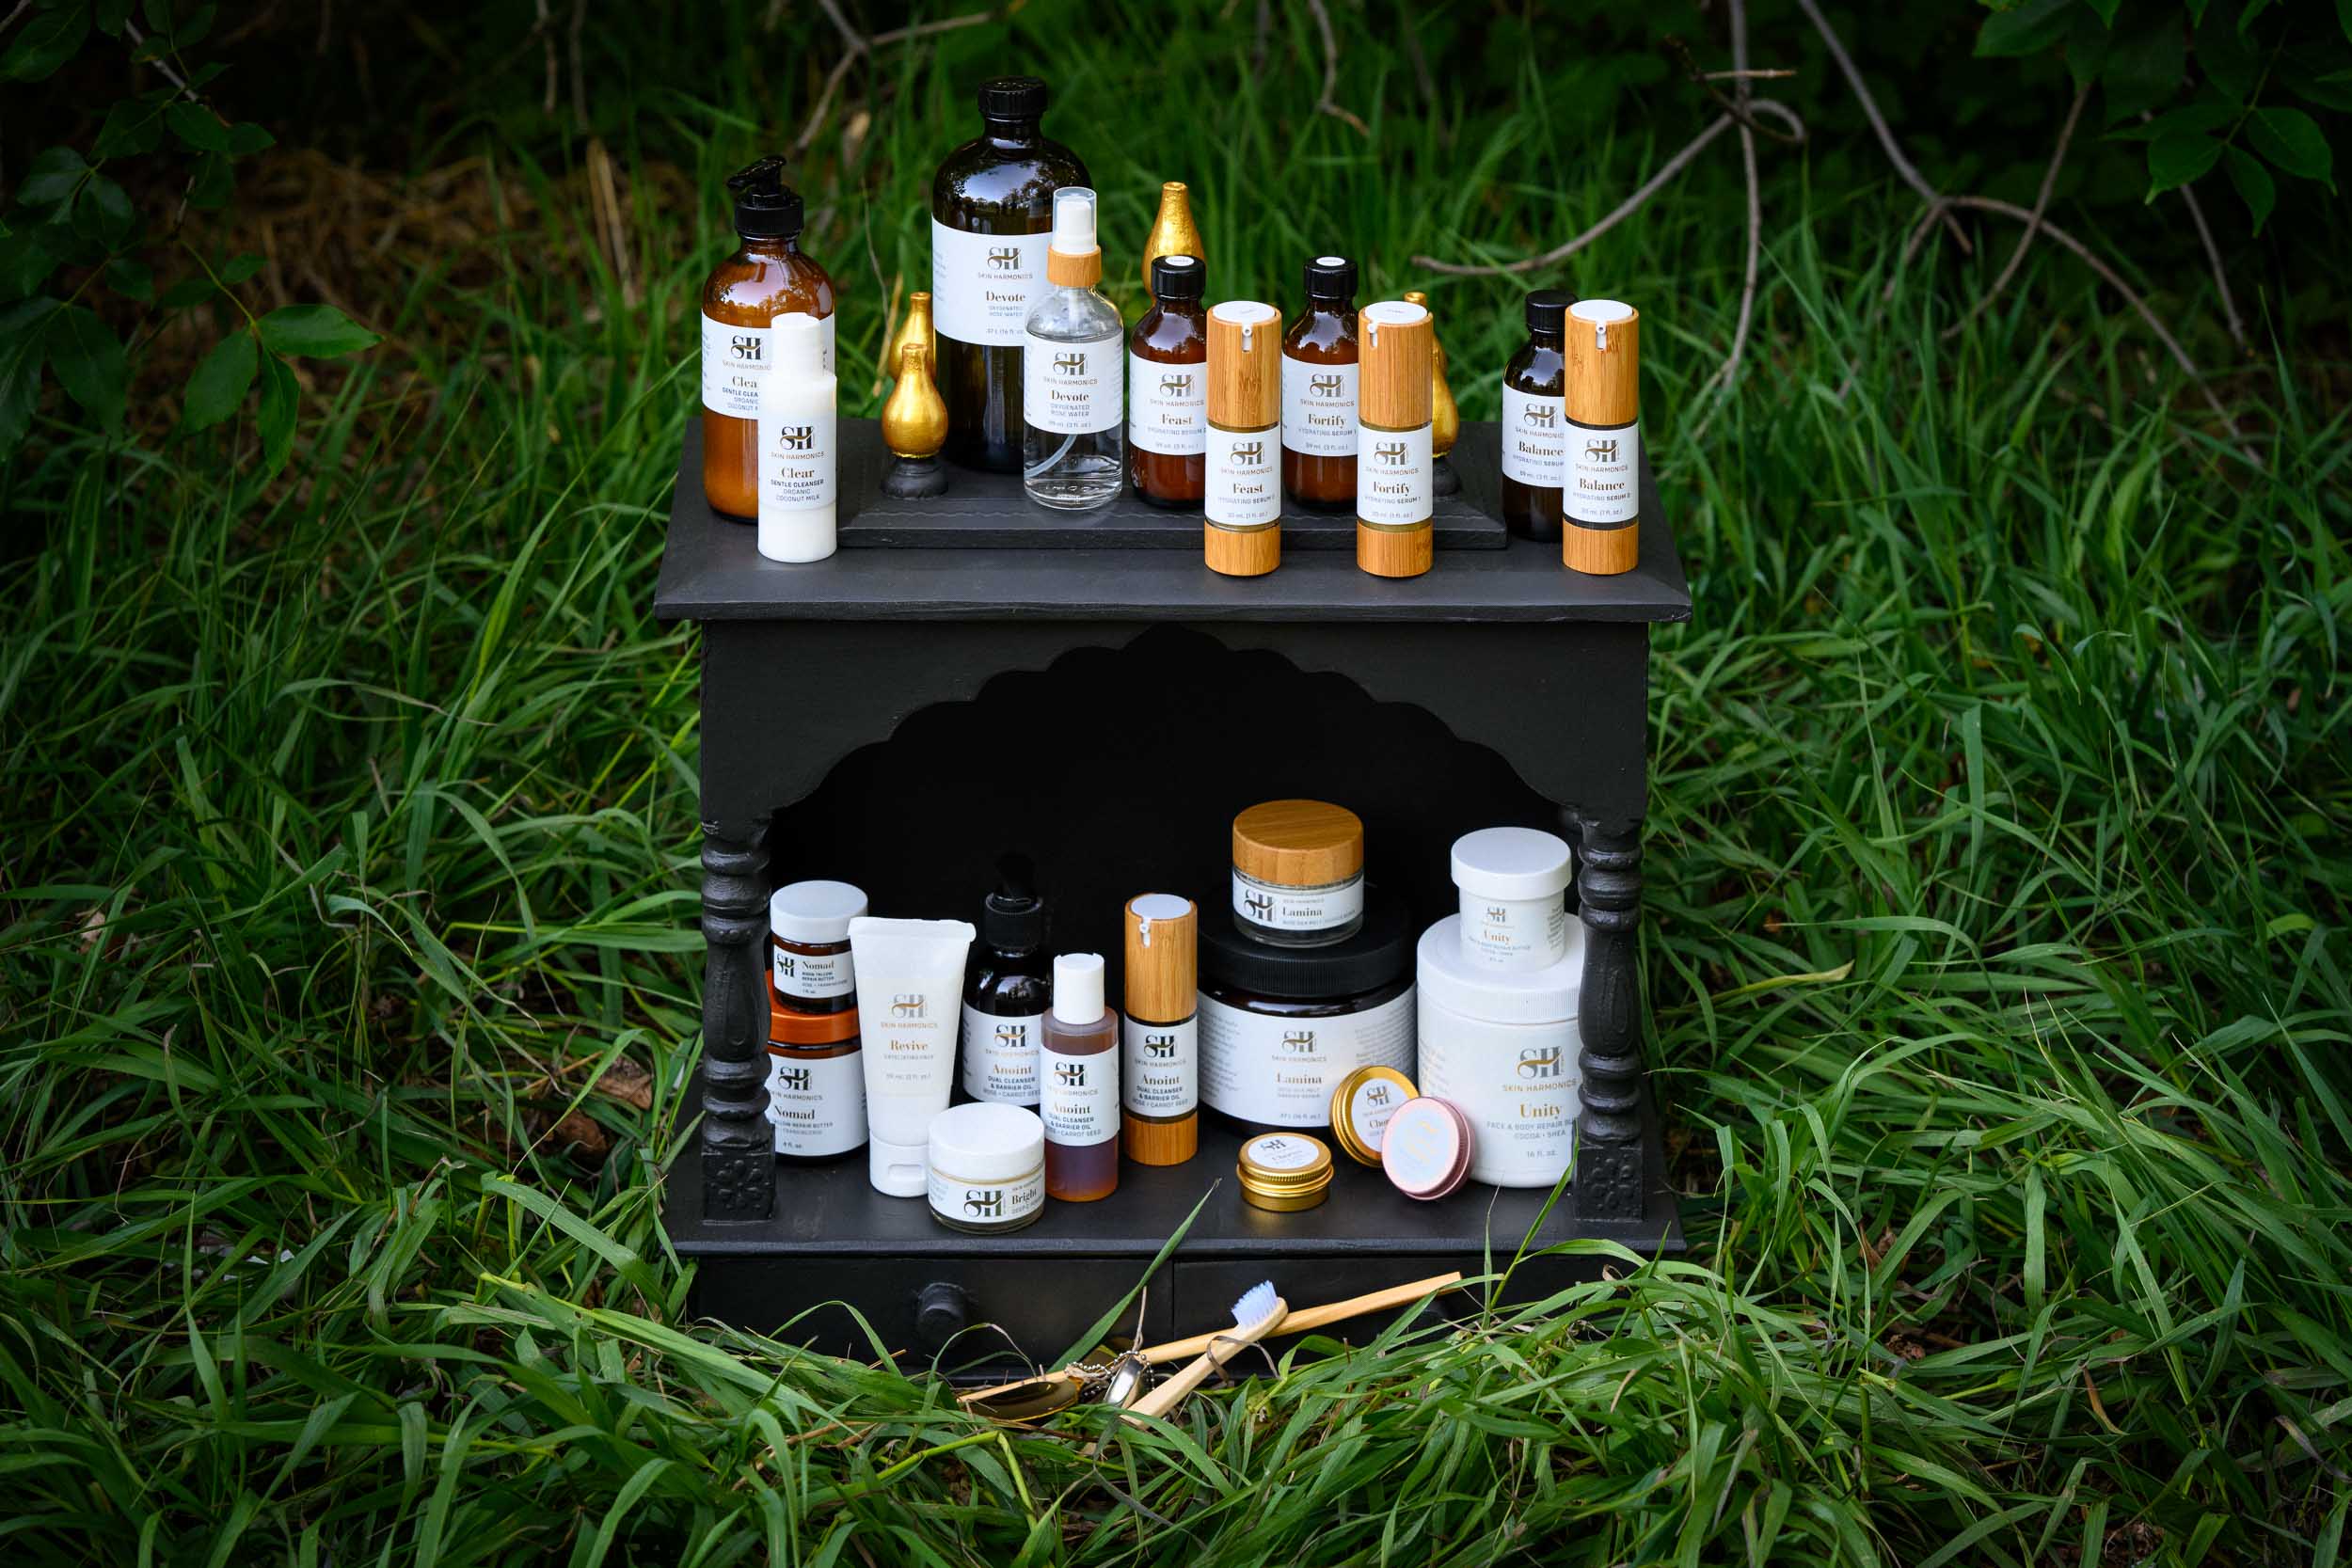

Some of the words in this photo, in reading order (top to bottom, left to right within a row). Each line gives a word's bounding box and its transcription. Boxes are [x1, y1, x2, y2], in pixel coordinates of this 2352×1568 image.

[986, 291, 1025, 302] Devote
[736, 362, 771, 371] HARMONIC
[732, 375, 757, 388] Clea
[1052, 389, 1089, 402] Devote
[1162, 413, 1192, 425] Feast
[1309, 413, 1344, 429] Fortify
[1518, 441, 1565, 455] Balance
[787, 451, 824, 460] HARMONICS
[781, 467, 815, 478] Clear
[1237, 467, 1273, 475] HARMONICS
[1591, 465, 1628, 473] HARMONICS
[793, 479, 824, 487] CLEANSER
[1233, 483, 1263, 494] Feast
[1580, 478, 1625, 490] Balance
[1374, 482, 1410, 497] Fortify
[1282, 907, 1322, 917] Lamina
[1484, 930, 1509, 944] Unity
[803, 959, 834, 971] Nomad
[891, 1039, 928, 1051] Revive
[994, 1064, 1032, 1075] Anoint
[1144, 1074, 1180, 1085] Anoint
[1278, 1072, 1322, 1084] Lamina
[1502, 1084, 1523, 1092] SKIN
[1526, 1078, 1577, 1092] HARMONICS
[774, 1105, 815, 1119] Nomad
[1054, 1102, 1091, 1115] Anoint
[1520, 1103, 1561, 1119] Unity
[1486, 1121, 1504, 1130] FACE
[1536, 1120, 1563, 1130] REPAIR
[1011, 1188, 1037, 1205] Bright
